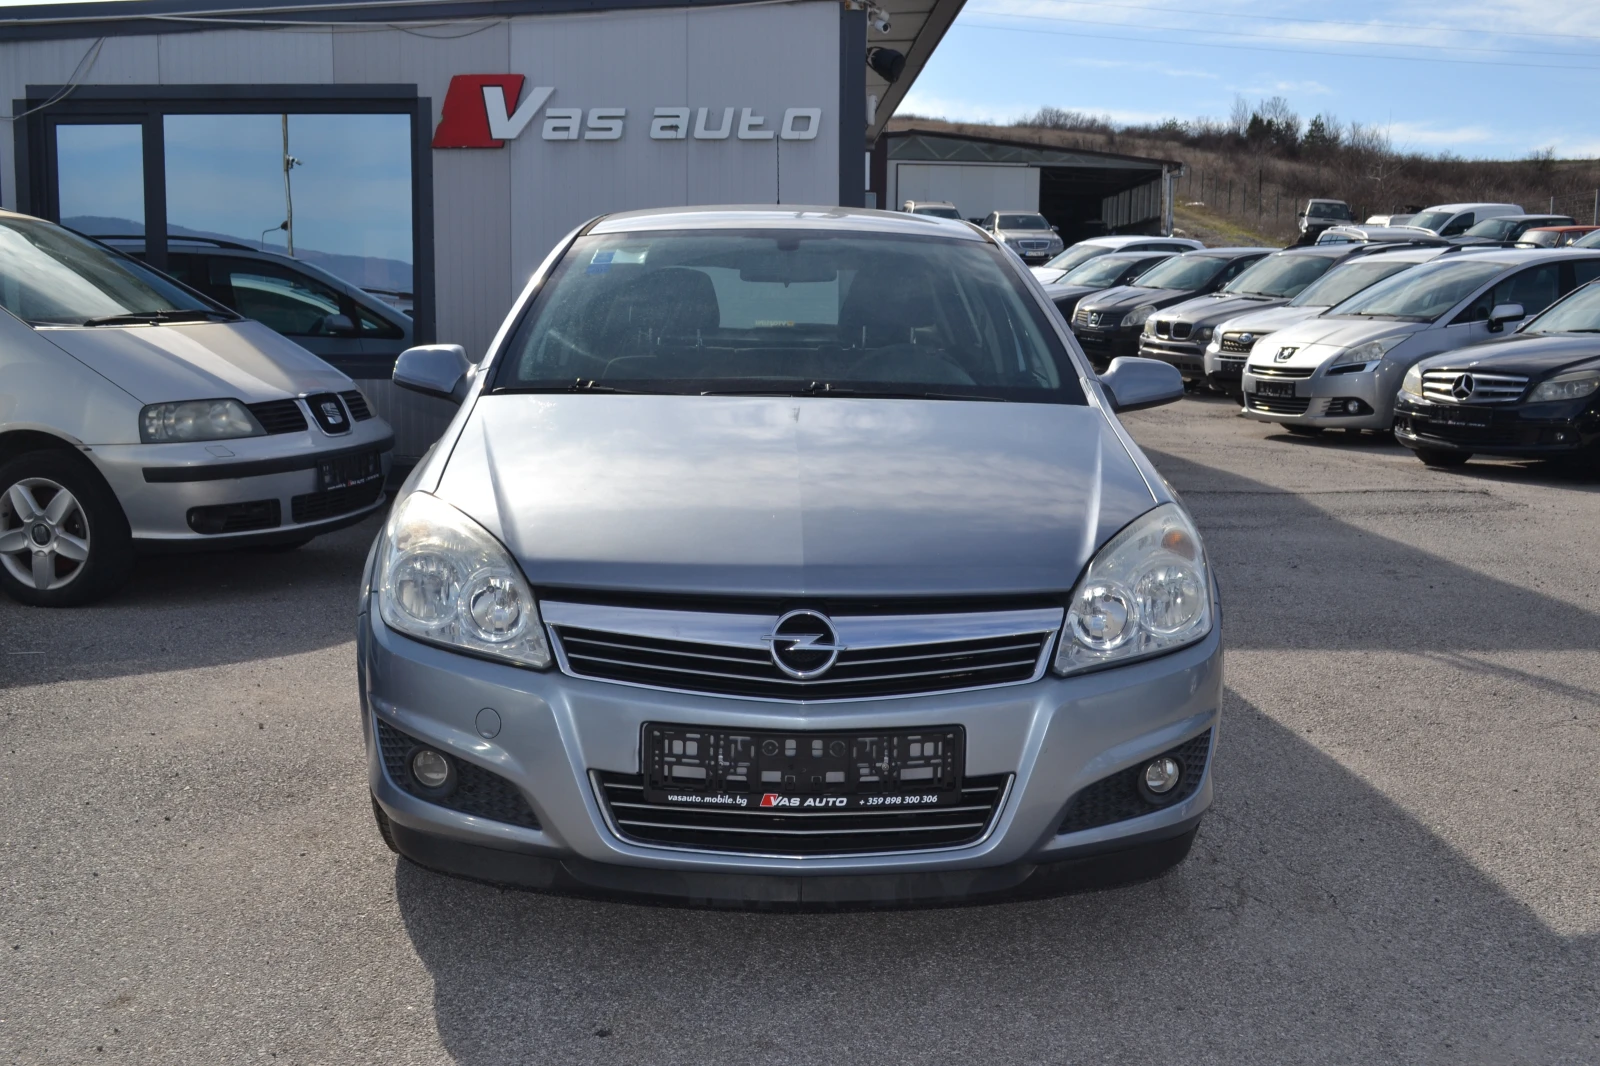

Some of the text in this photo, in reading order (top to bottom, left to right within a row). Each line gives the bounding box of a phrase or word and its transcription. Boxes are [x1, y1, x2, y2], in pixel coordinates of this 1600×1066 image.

[482, 86, 822, 140] Vas auto
[668, 794, 748, 807] vasauto.mobile.bg
[770, 796, 847, 807] VAS AUTO
[867, 797, 884, 805] 359
[885, 796, 902, 804] 898
[903, 795, 920, 804] 300
[921, 794, 938, 803] 306
